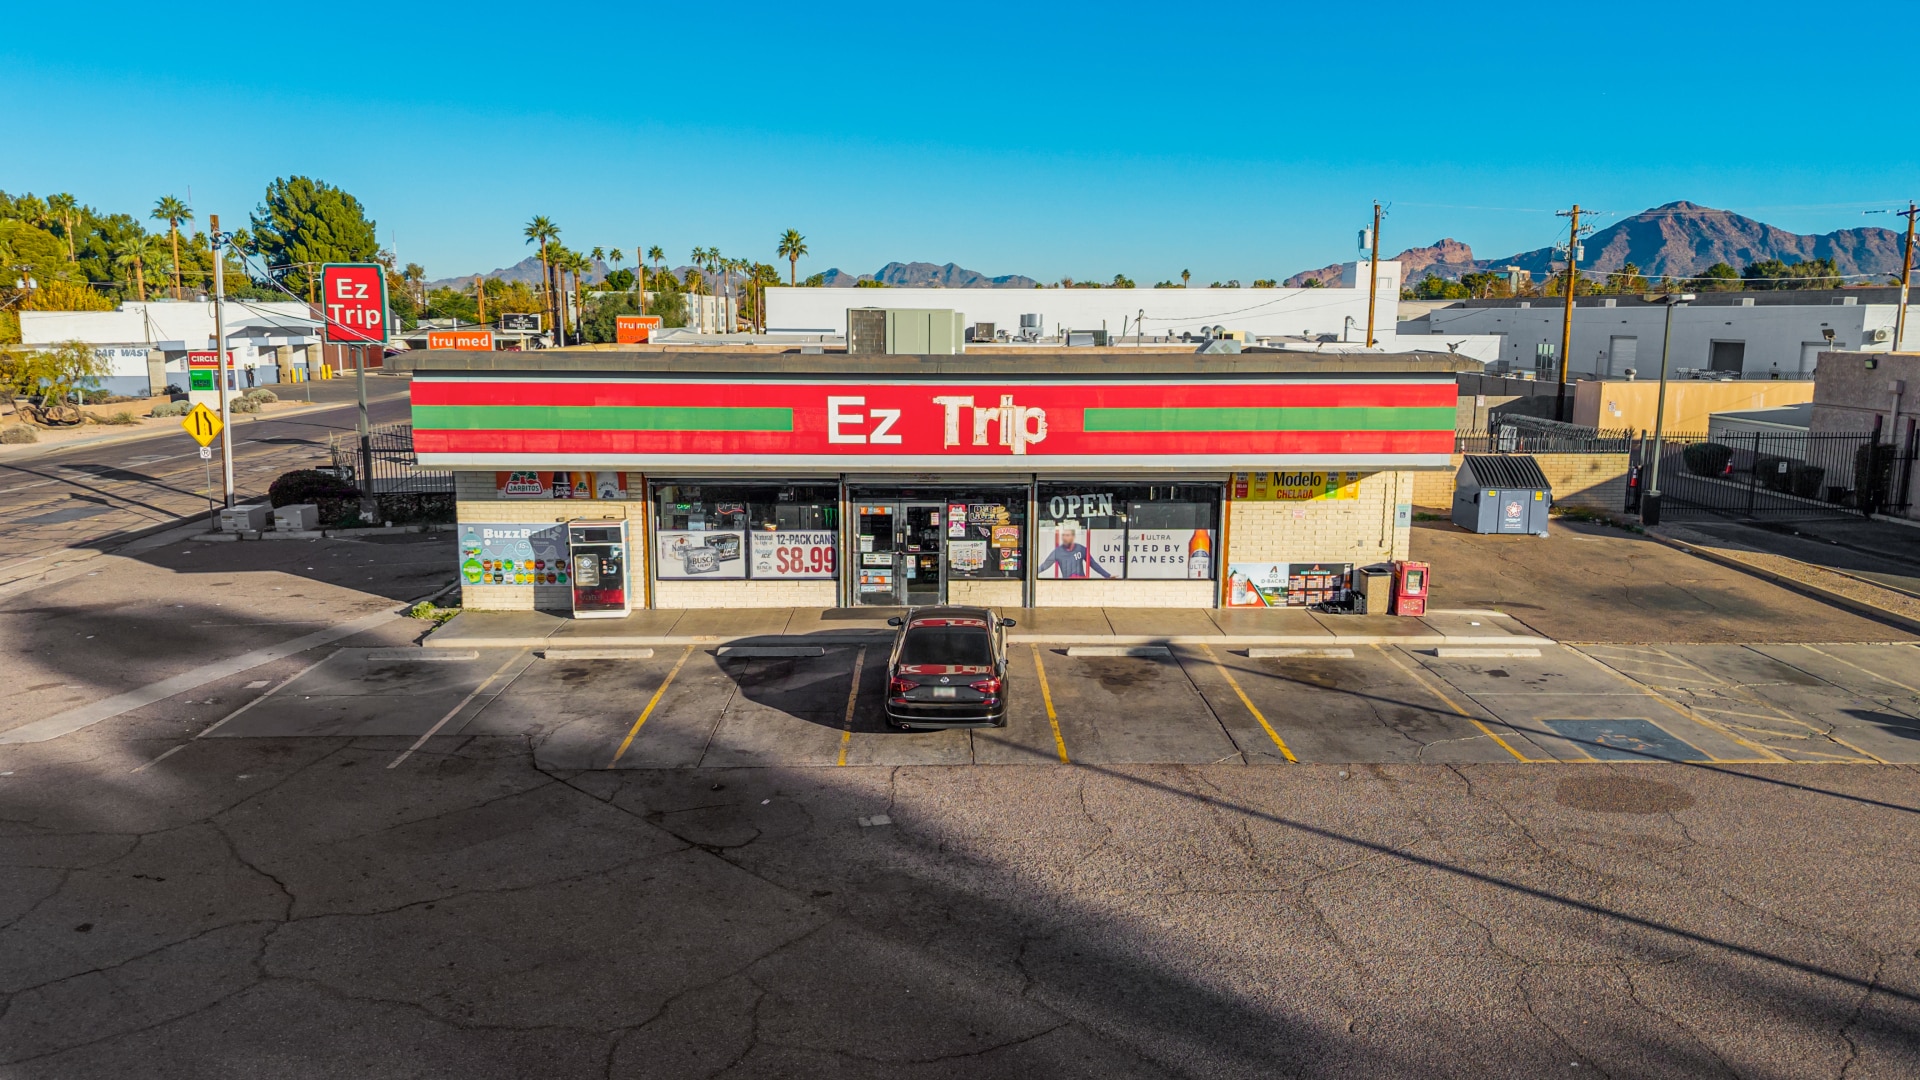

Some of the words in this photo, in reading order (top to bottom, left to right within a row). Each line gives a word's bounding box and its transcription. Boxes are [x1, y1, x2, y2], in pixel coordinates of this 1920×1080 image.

[336, 278, 369, 299] Ez
[328, 304, 381, 329] Trip
[95, 349, 115, 357] CAR
[191, 355, 218, 363] CIRCLE
[827, 395, 902, 444] Ez
[933, 394, 1048, 455] Trip
[1273, 472, 1321, 487] Modelo
[1276, 489, 1314, 499] CHELADA
[1050, 493, 1114, 519] OPEN
[776, 534, 812, 545] 12-PACK
[813, 534, 836, 545] CANS
[1103, 544, 1159, 552] UNITED
[1164, 544, 1181, 552] BY
[776, 546, 837, 575] $8.99
[1074, 551, 1082, 560] 10
[1098, 555, 1184, 563] GREATNESS
